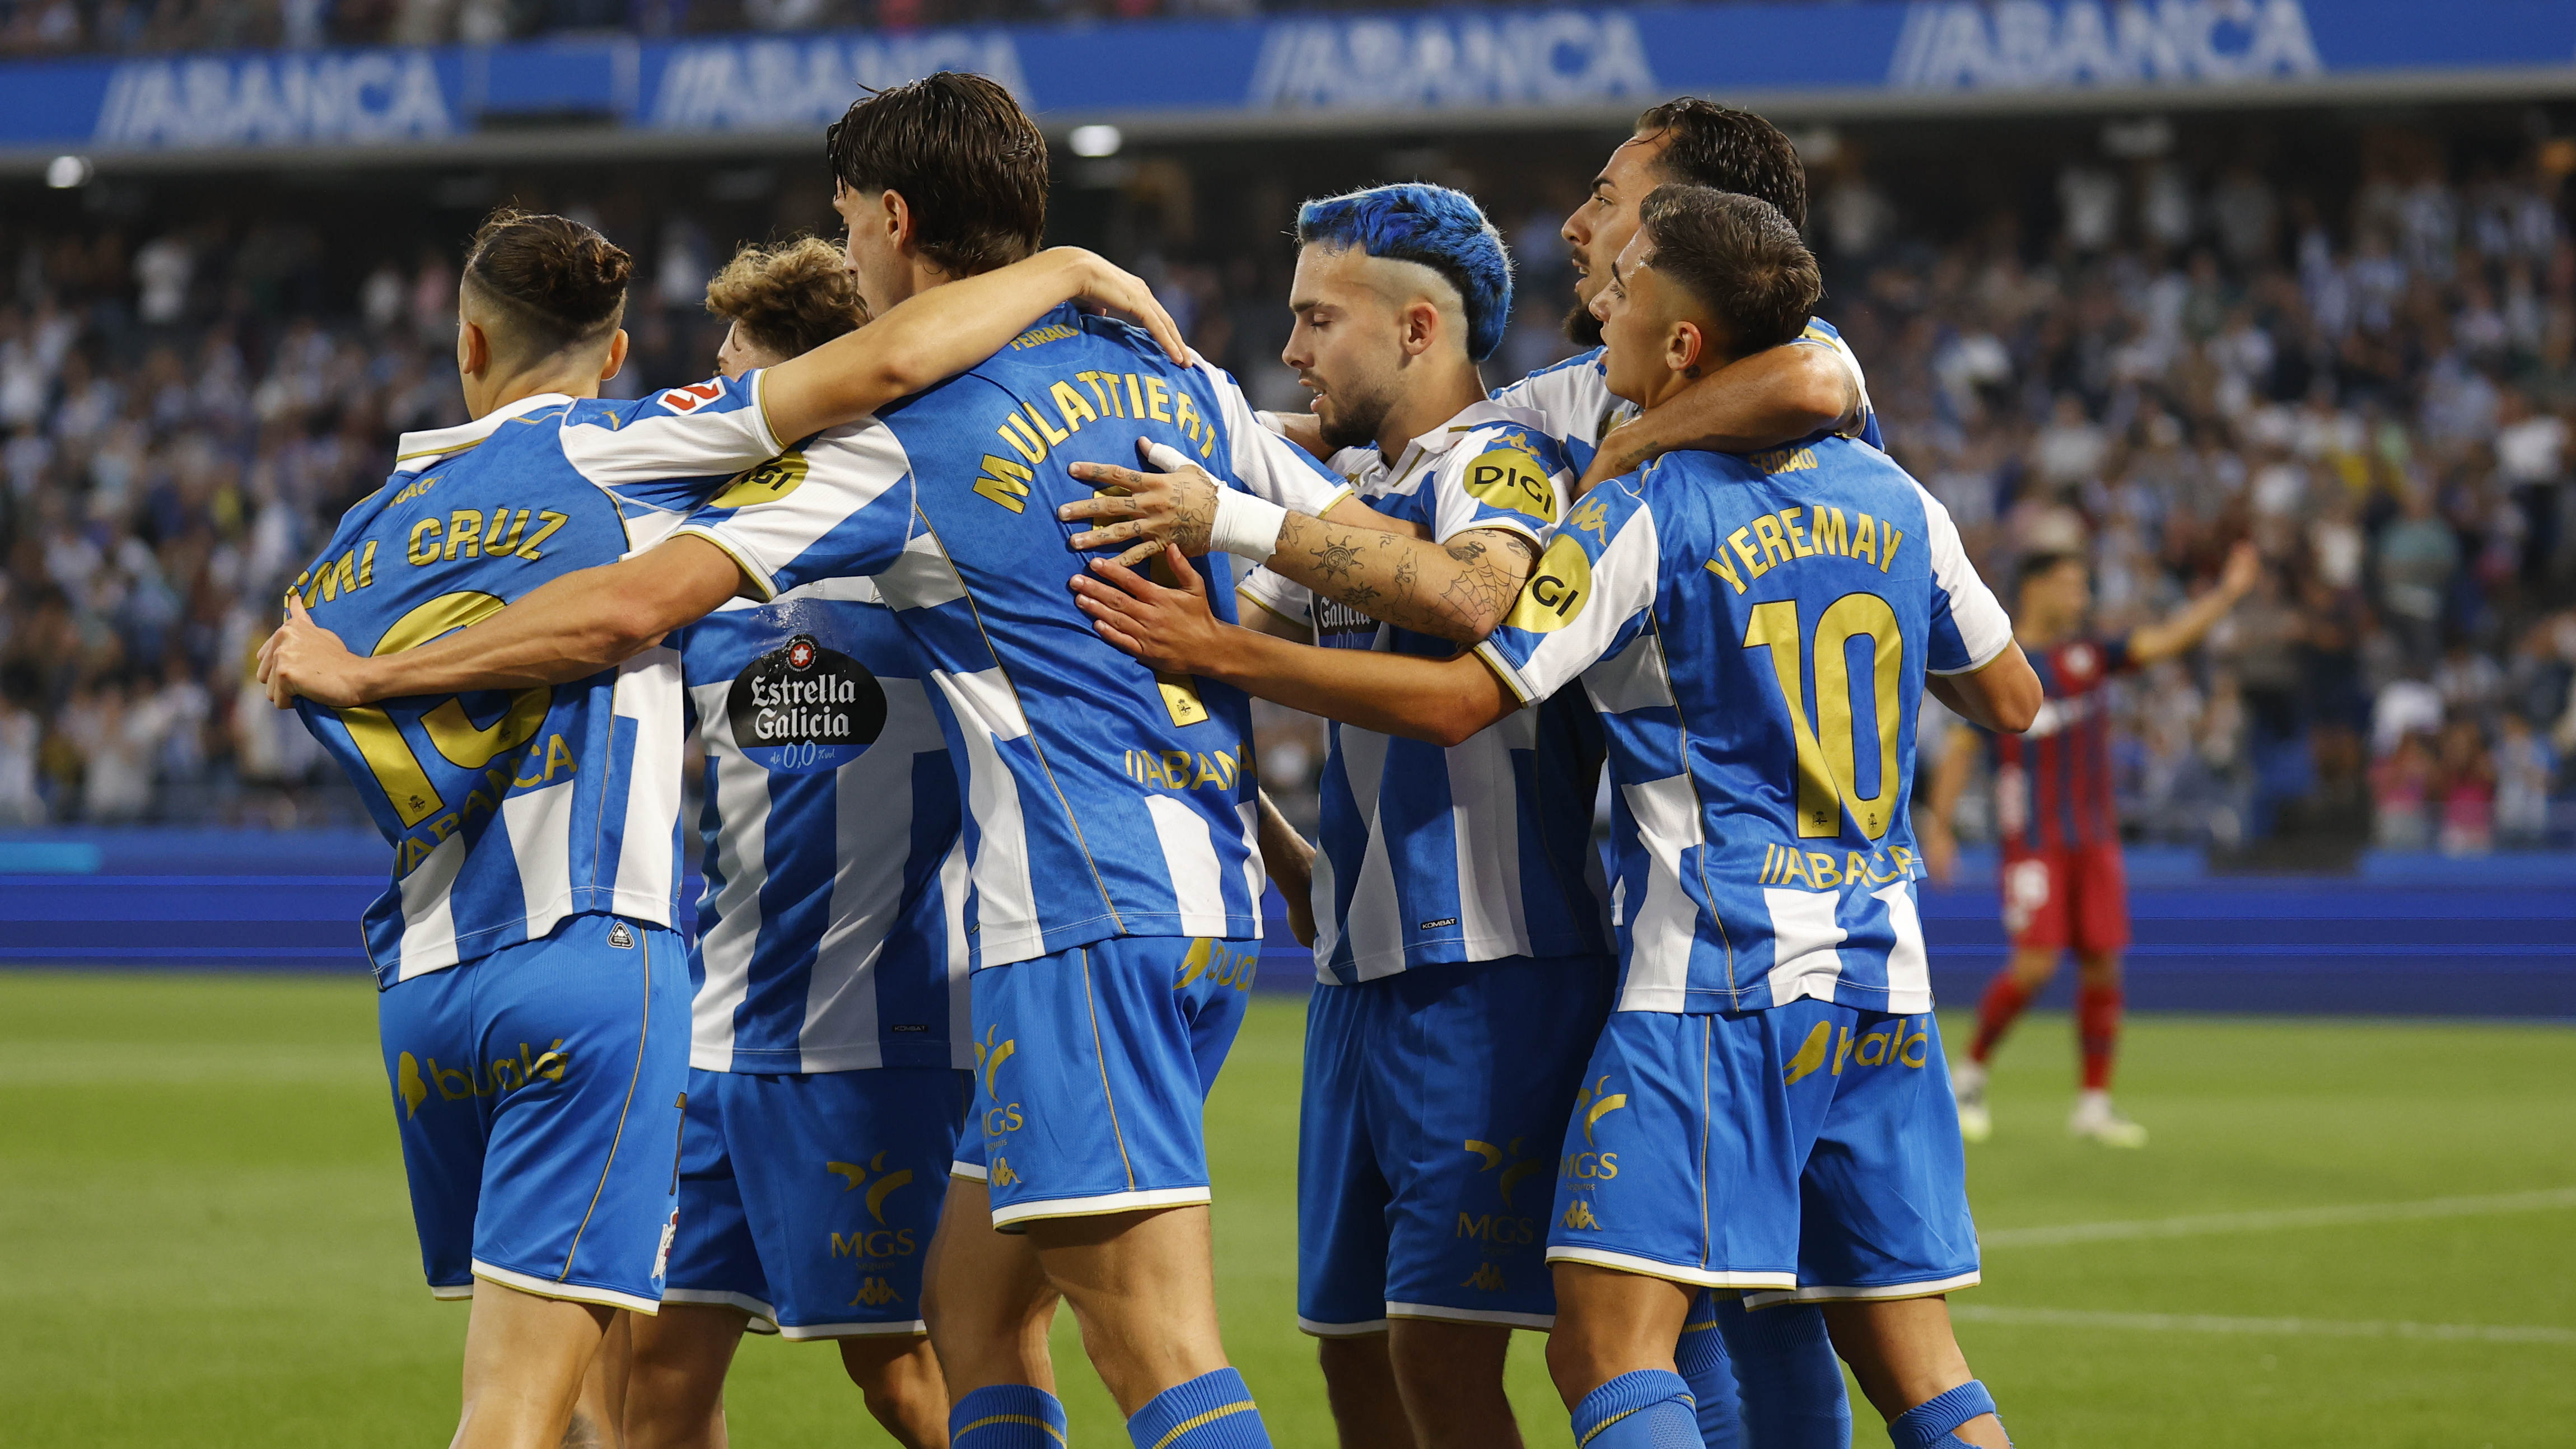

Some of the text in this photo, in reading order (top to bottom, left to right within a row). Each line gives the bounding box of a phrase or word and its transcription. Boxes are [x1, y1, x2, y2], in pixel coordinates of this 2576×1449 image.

[1245, 12, 1659, 109] ABANCA
[1886, 0, 2327, 90] ABANCA
[91, 54, 450, 147] ABANCA
[972, 370, 1216, 515] MULATTIERI
[1474, 465, 1551, 514] DIGI
[407, 507, 570, 567] CRUZ
[1704, 504, 1904, 595] YEREMAY
[1532, 575, 1579, 617] GI
[751, 674, 856, 707] Estrella
[755, 707, 851, 740] Galicia
[1740, 591, 1903, 841] 10
[783, 739, 816, 769] 0,0
[1422, 919, 1455, 929] KOMBAT
[1559, 1152, 1618, 1180] MGS
[830, 1228, 916, 1258] MGS
[1457, 1212, 1534, 1245] MGS
